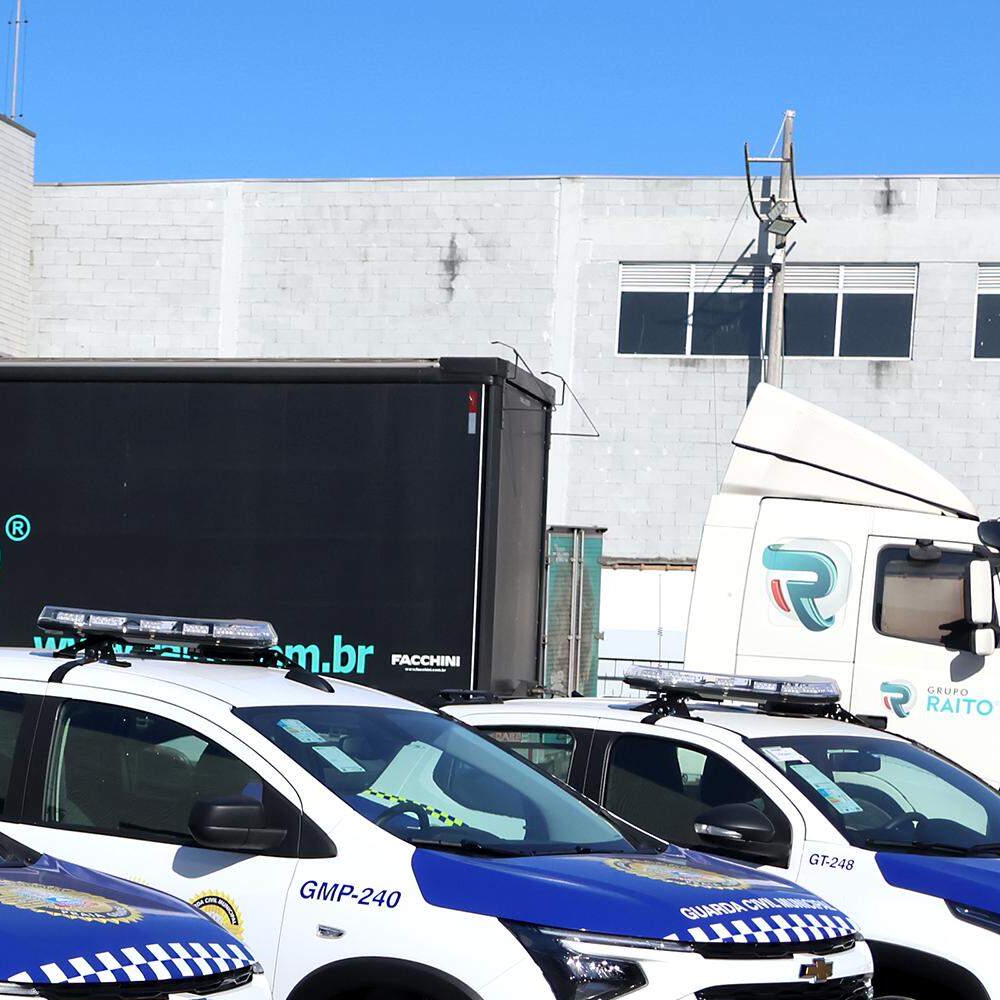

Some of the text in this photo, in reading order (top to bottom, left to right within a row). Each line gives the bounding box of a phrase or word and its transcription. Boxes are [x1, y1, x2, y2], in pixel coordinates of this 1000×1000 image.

[391, 654, 461, 667] FACCHINI
[927, 686, 968, 696] GRUPO
[926, 695, 993, 715] RAITO
[809, 853, 854, 870] GT-248
[299, 880, 402, 908] GMP-240
[680, 901, 747, 920] GUARDA
[742, 898, 782, 910] CIVIL
